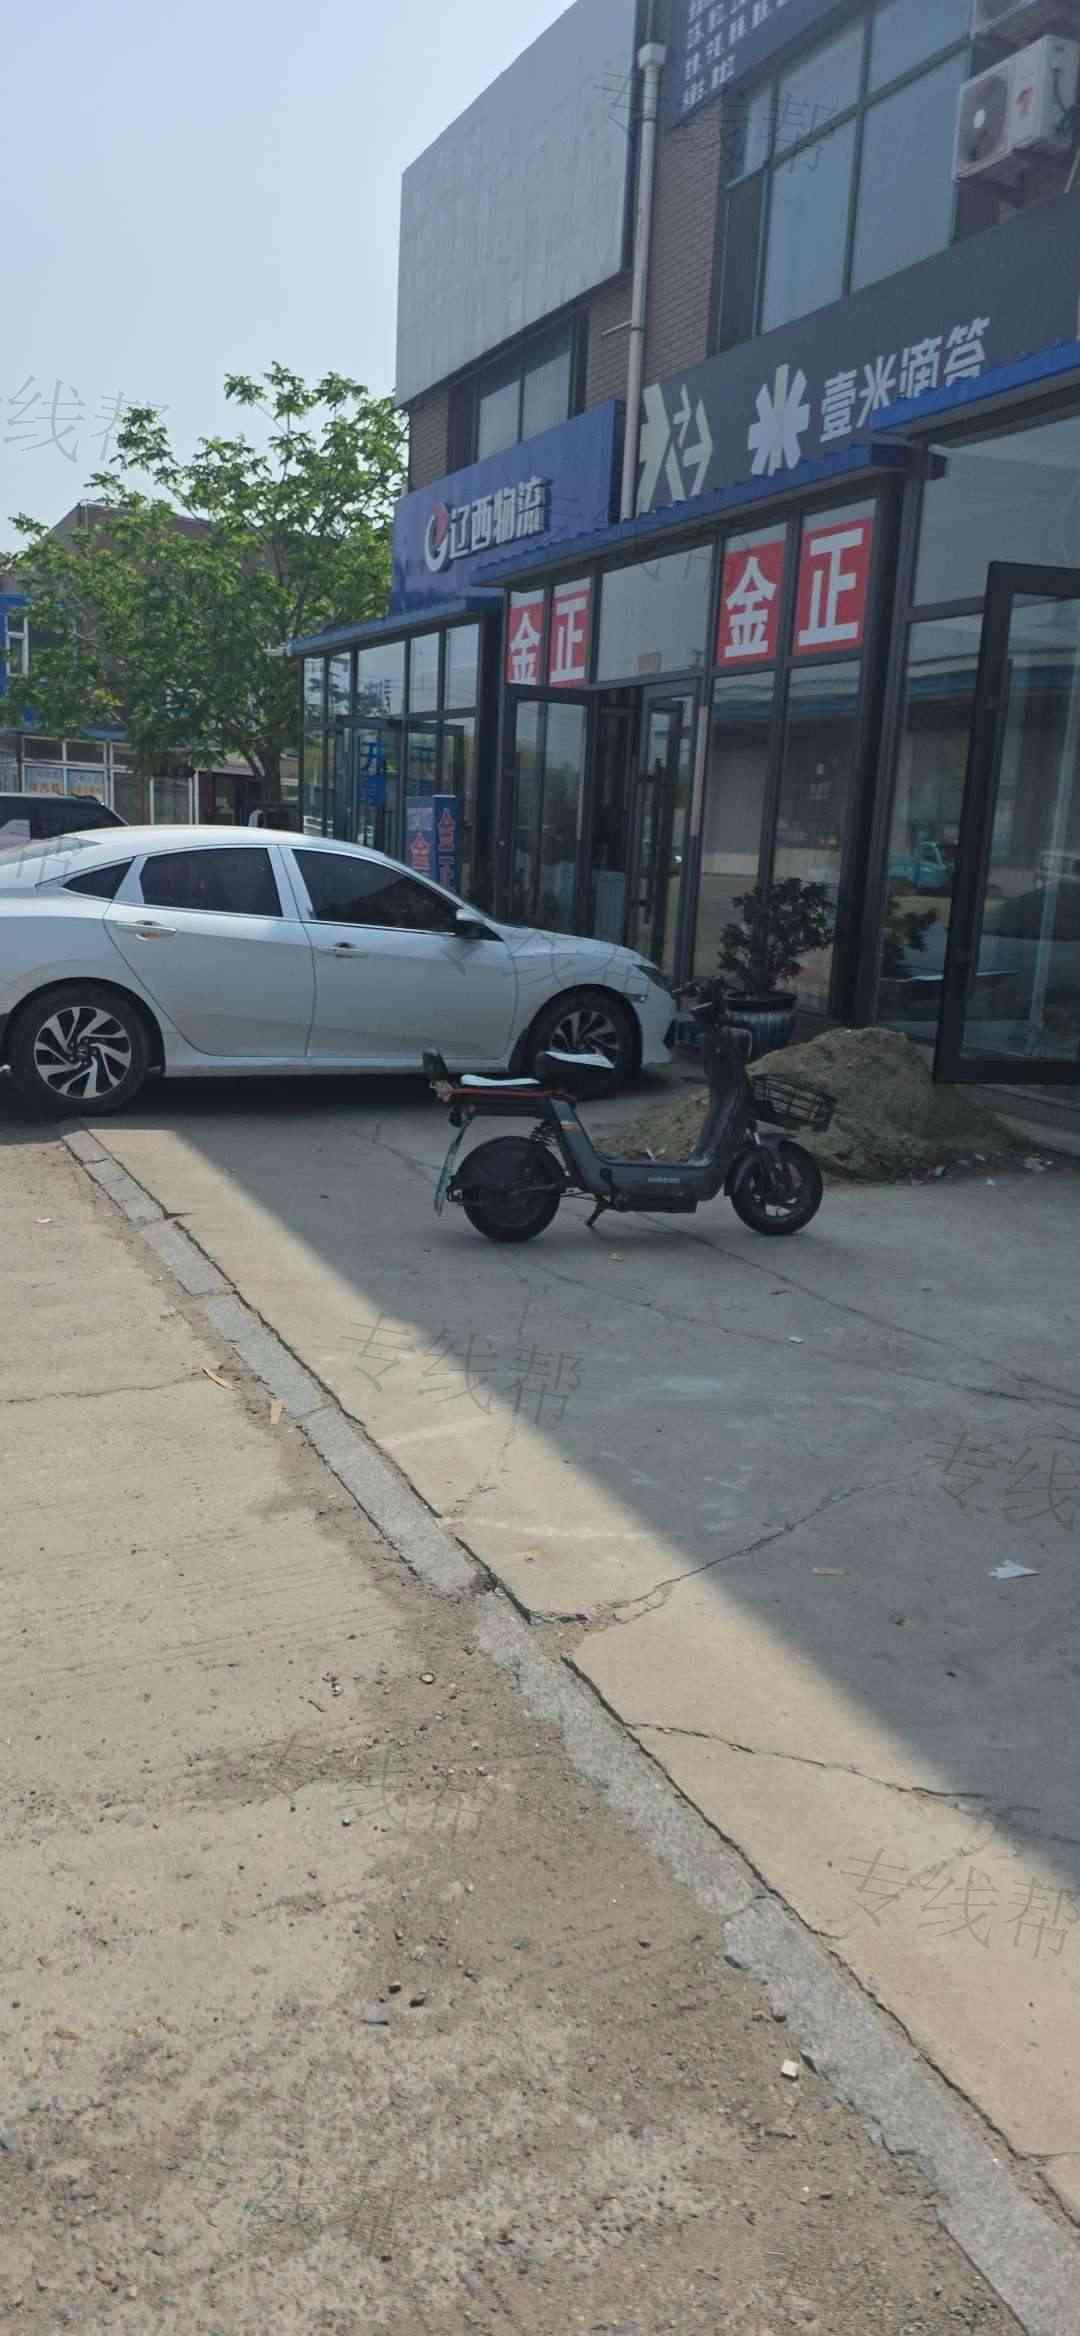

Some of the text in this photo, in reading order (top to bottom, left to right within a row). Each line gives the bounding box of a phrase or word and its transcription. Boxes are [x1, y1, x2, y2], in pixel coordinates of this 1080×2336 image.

[449, 475, 545, 559] 辽西物流
[723, 526, 865, 659] 金正
[509, 596, 588, 686] 金正
